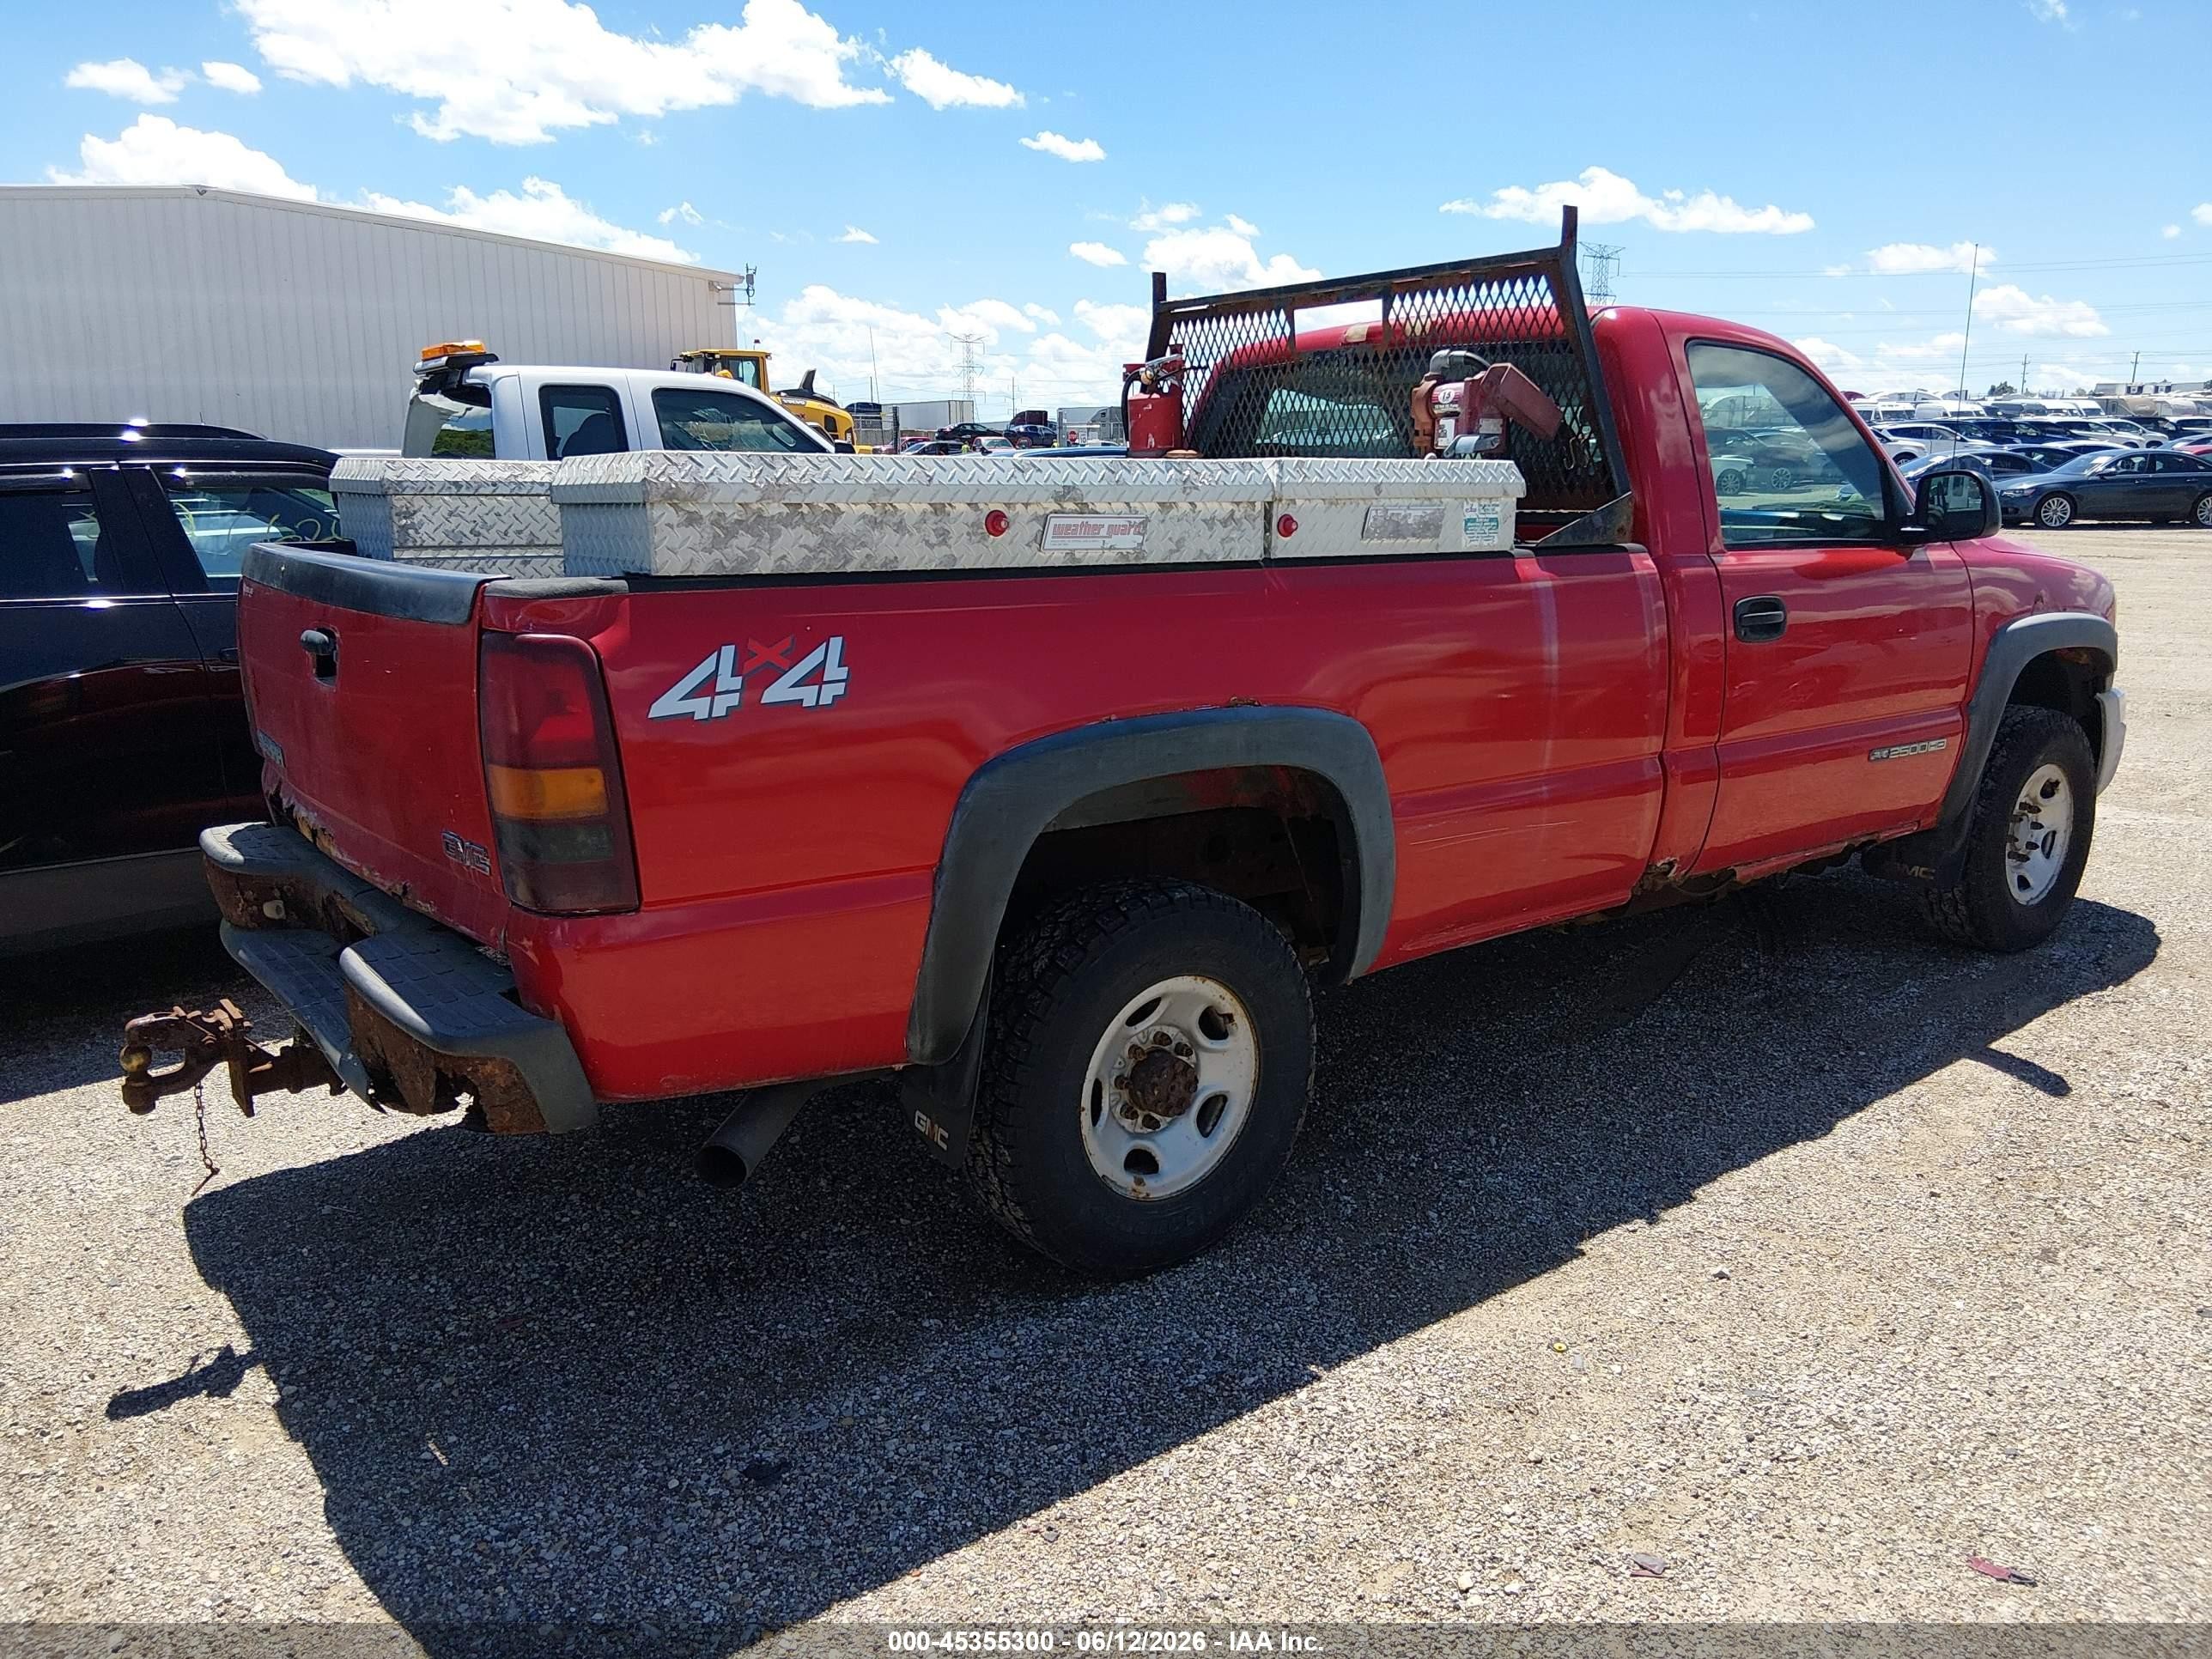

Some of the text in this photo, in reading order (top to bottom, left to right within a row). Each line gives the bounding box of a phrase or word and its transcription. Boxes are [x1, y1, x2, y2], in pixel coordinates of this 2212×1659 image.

[1052, 521, 1105, 536] weather
[441, 830, 490, 877] GMC
[915, 1109, 949, 1152] GMC
